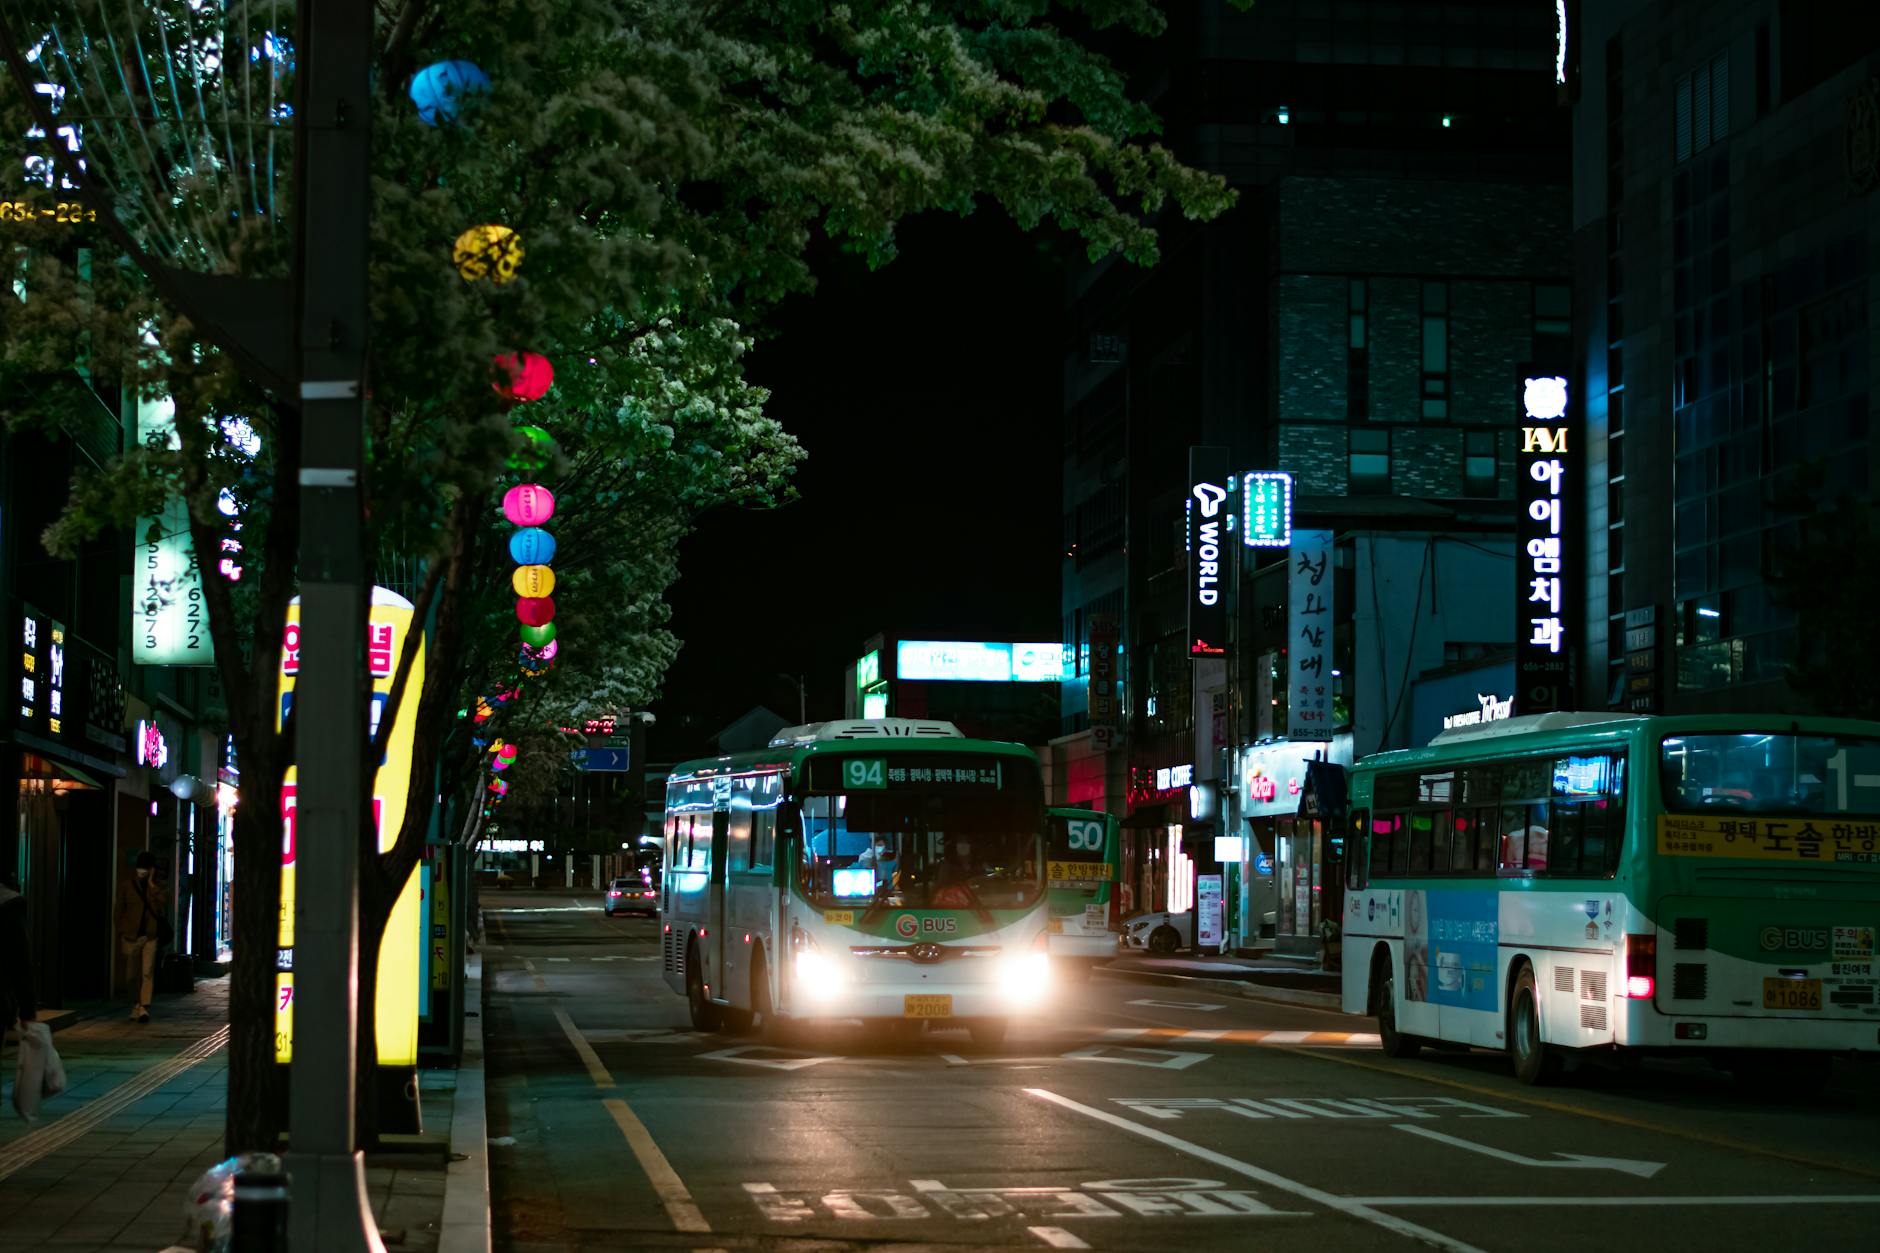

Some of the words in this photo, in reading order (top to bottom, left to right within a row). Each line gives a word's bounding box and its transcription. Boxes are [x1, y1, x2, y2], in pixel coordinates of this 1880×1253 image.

[1199, 522, 1219, 606] WORLD
[1297, 551, 1327, 679] 청와삼대
[1095, 729, 1115, 747] 약
[850, 760, 883, 786] 94
[1068, 821, 1103, 850] 50
[1719, 821, 1756, 843] 평택
[1764, 822, 1823, 858] 도솔
[1067, 862, 1109, 876] 한방병원
